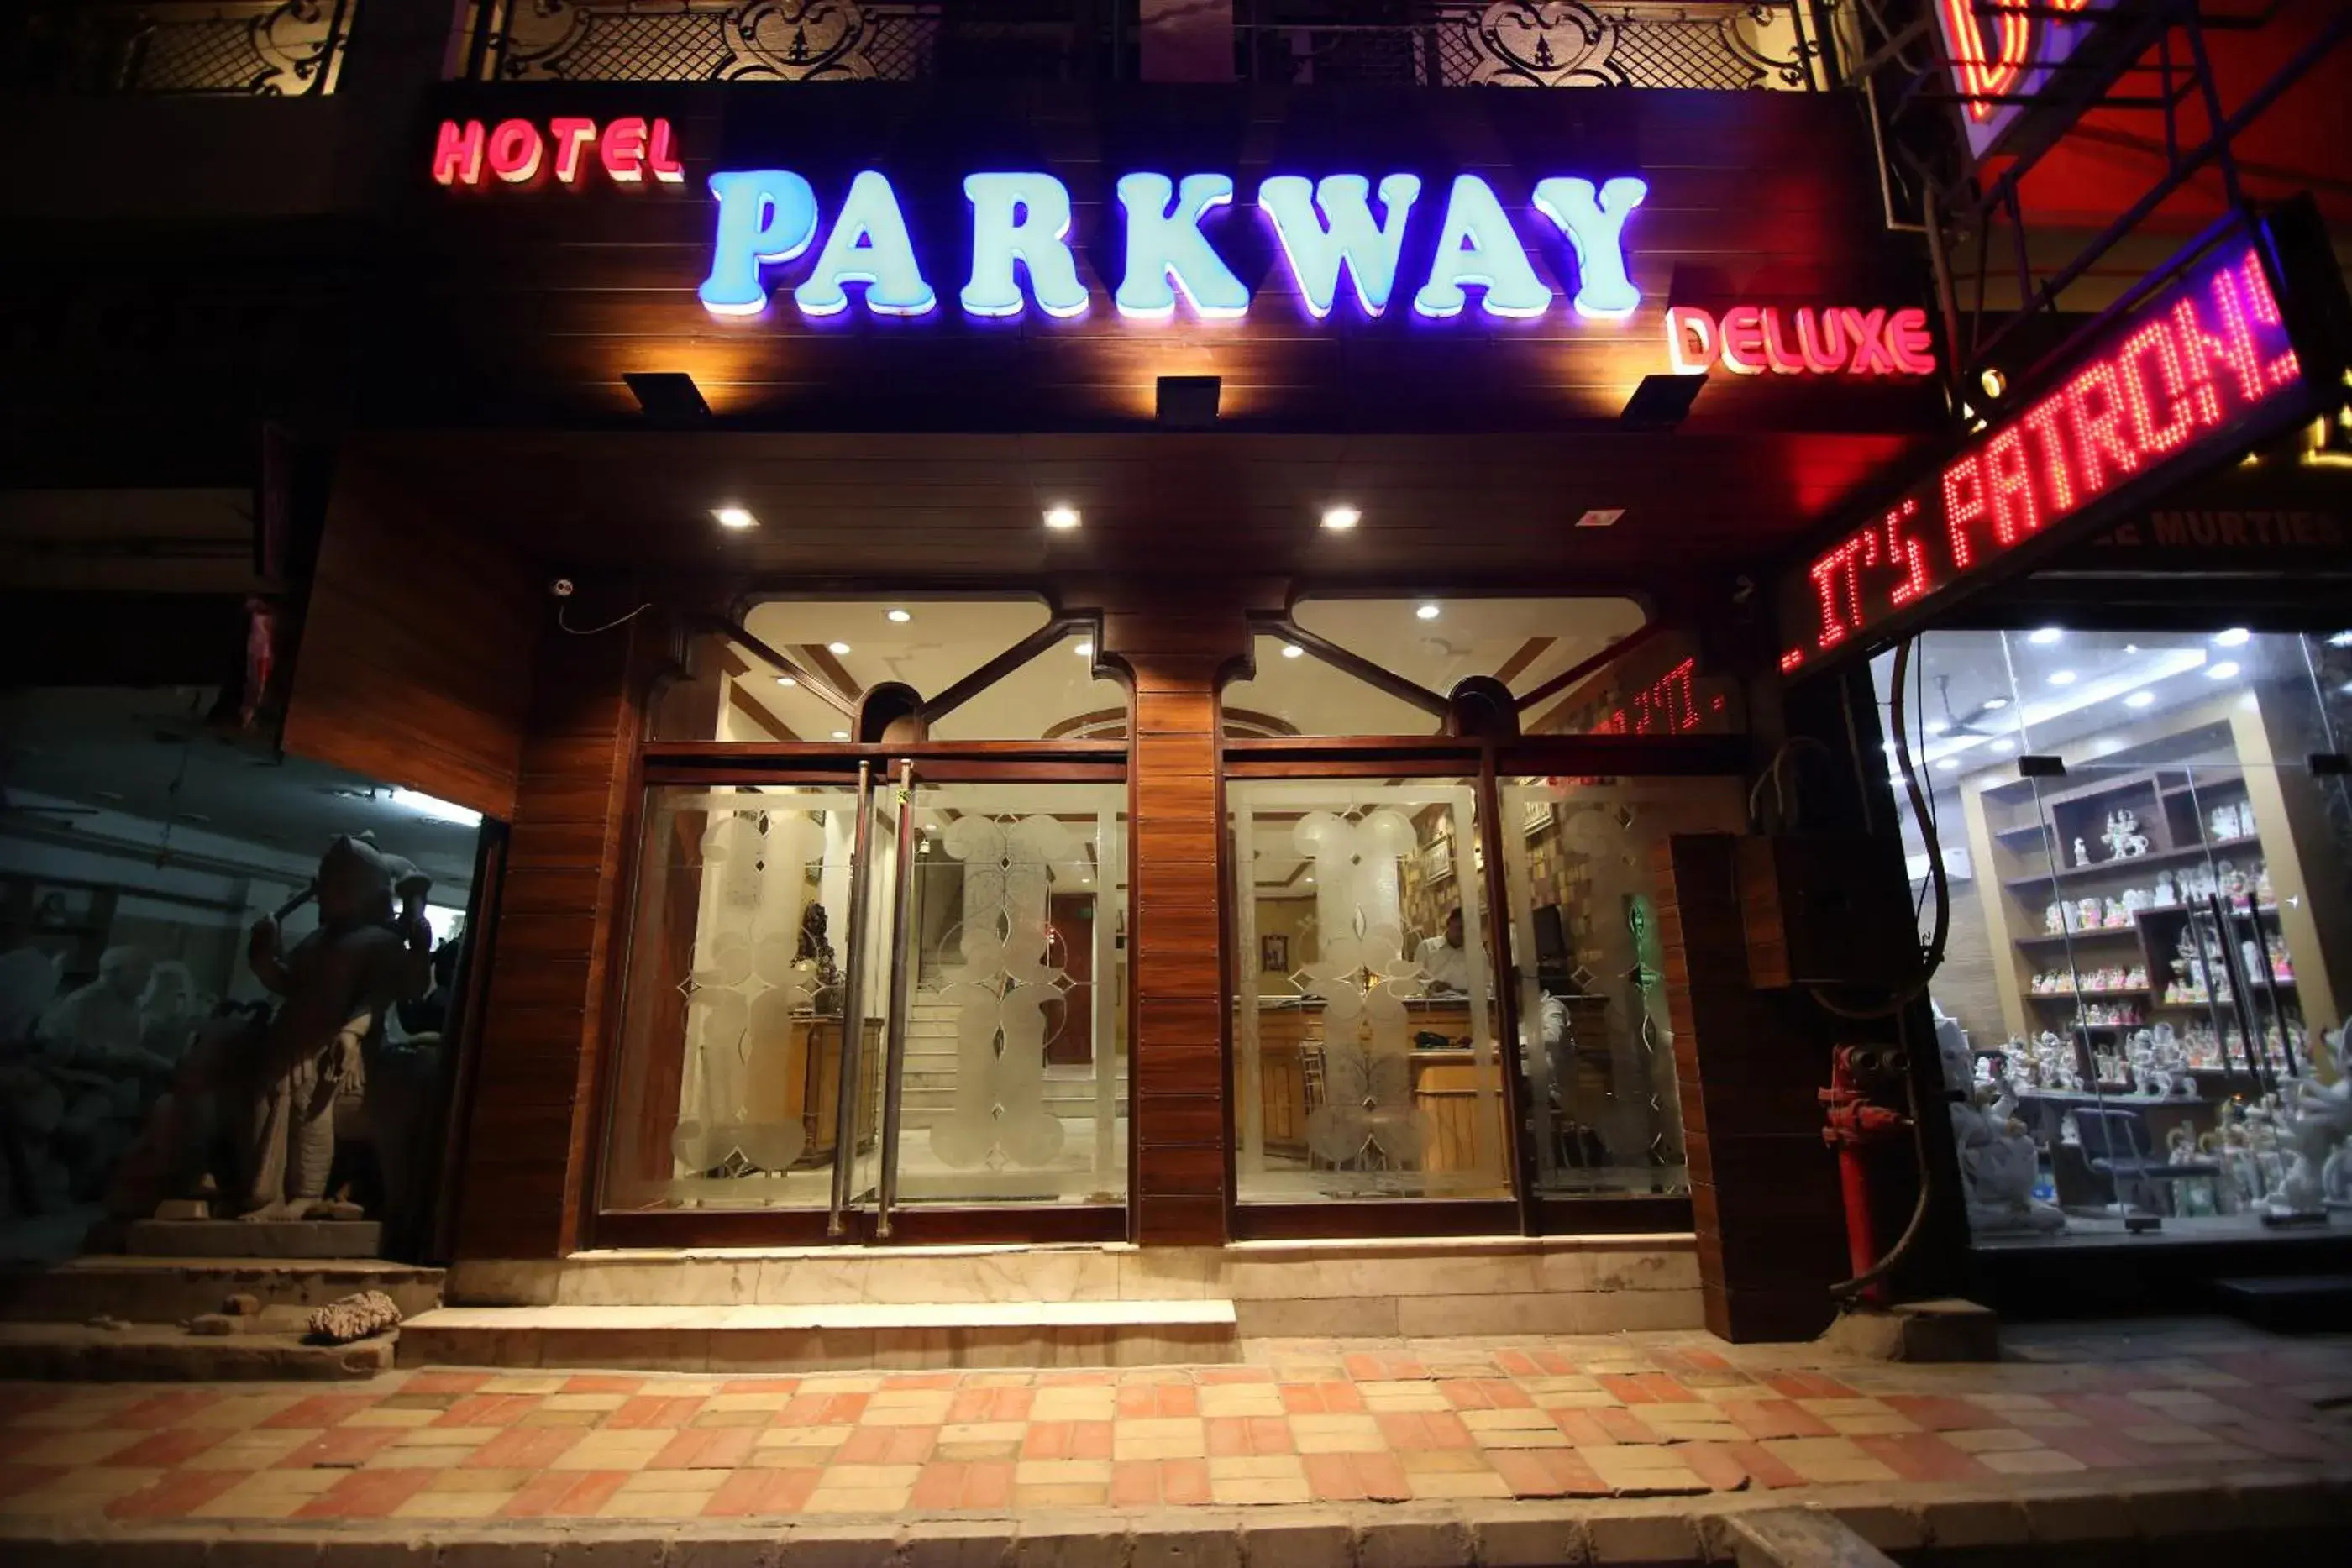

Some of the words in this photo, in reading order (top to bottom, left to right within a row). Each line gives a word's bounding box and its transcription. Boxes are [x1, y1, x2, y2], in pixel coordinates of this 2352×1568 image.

[432, 117, 685, 186] HOTEL
[699, 170, 1648, 320] PARKWAY
[1665, 305, 1936, 376] DELUXE
